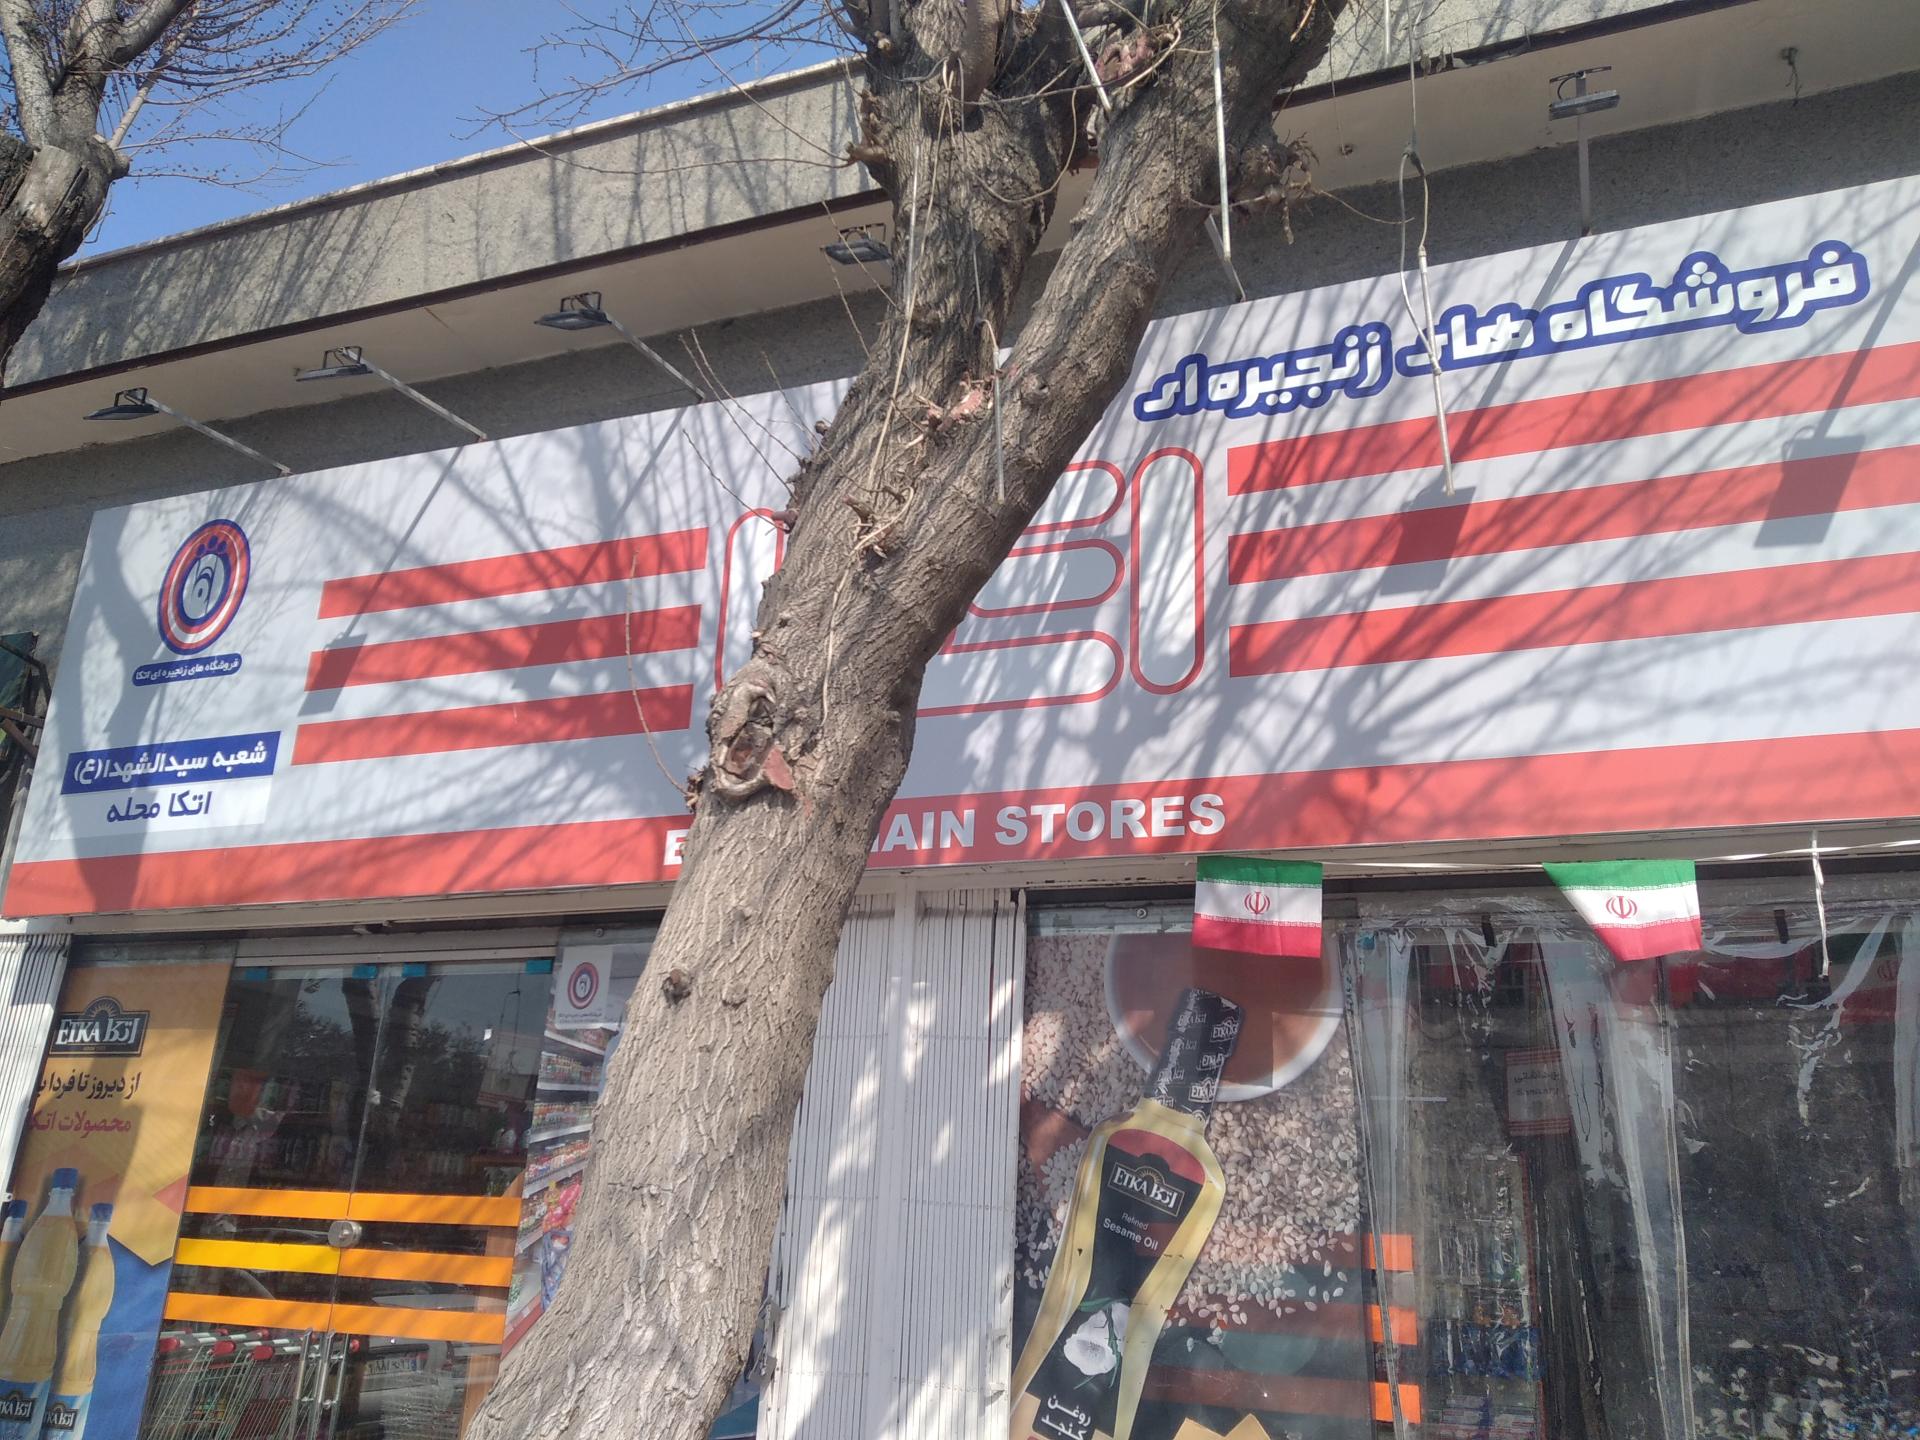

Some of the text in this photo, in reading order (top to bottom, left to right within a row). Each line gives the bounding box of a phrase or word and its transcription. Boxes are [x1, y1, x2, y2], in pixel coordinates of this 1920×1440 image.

[1138, 245, 1864, 417] فروشگاه های زنجیره ای
[150, 669, 161, 681] ای
[162, 665, 188, 679] زنجیره
[188, 664, 204, 676] های
[205, 658, 239, 671] فروشگاه
[211, 740, 268, 773] شعبه
[106, 790, 213, 823] اتکا محله
[871, 794, 1225, 852] AIN STORES
[55, 1019, 100, 1045] ETKA
[103, 1018, 141, 1044] اتکا
[48, 1069, 76, 1099] فردا
[77, 1072, 90, 1091] تا
[86, 1076, 125, 1099] دیروز
[125, 1072, 142, 1099] از
[30, 1110, 131, 1138] محصولات اتک
[1113, 1166, 1147, 1195] ETKA
[1149, 1183, 1178, 1208] اتکا
[1103, 1217, 1159, 1251] Sesame Oil
[1121, 1212, 1149, 1231] Refined
[1047, 1394, 1091, 1427] روغن
[1041, 1414, 1087, 1440] کنجد
